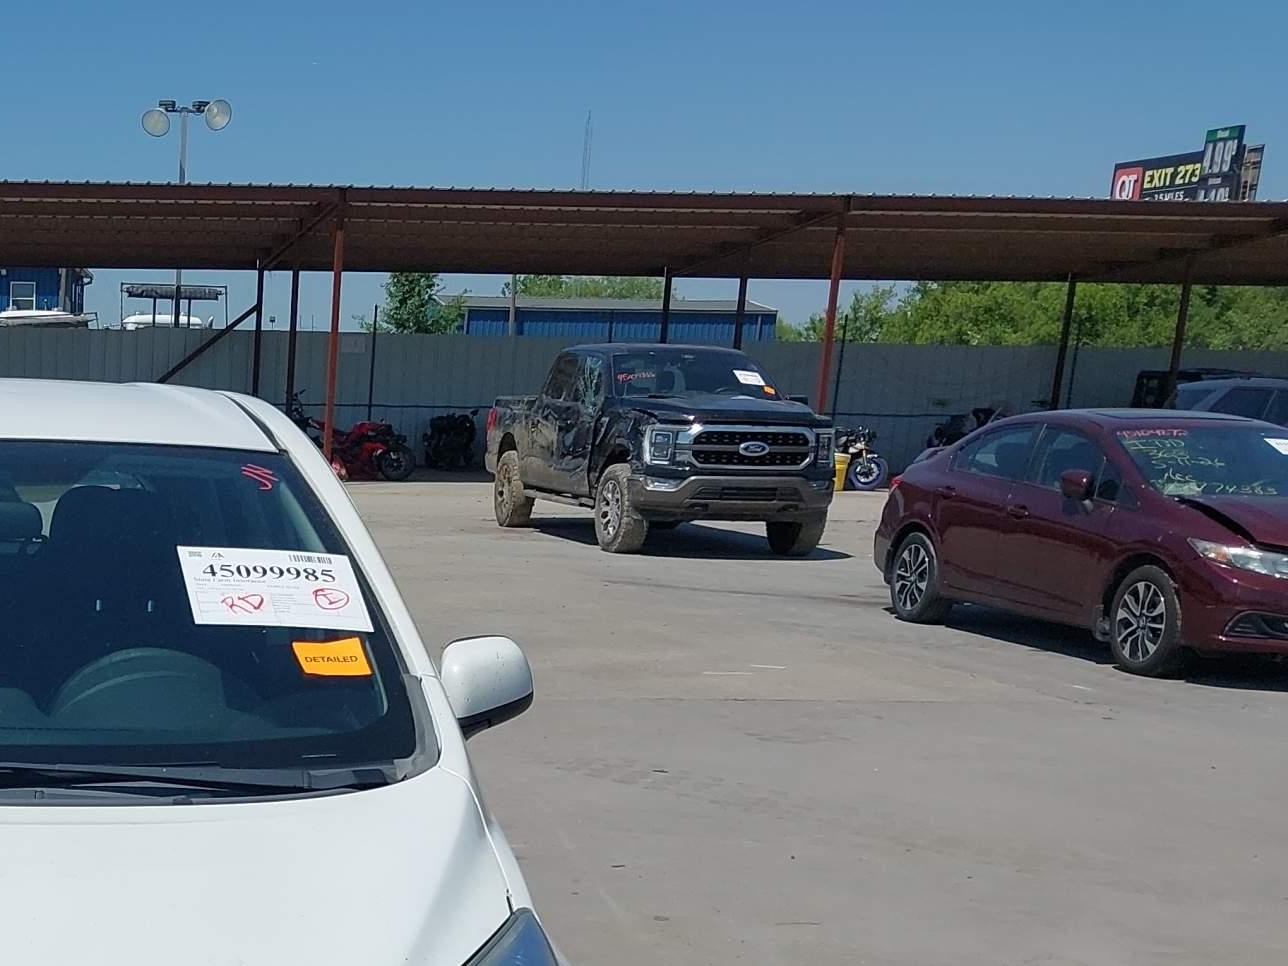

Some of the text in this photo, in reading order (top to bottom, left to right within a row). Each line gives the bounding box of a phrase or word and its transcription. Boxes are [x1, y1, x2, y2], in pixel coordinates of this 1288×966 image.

[1116, 174, 1137, 200] QT
[1144, 163, 1202, 189] EXIT 273
[203, 564, 336, 583] 45099985
[305, 655, 358, 664] DETAILED
